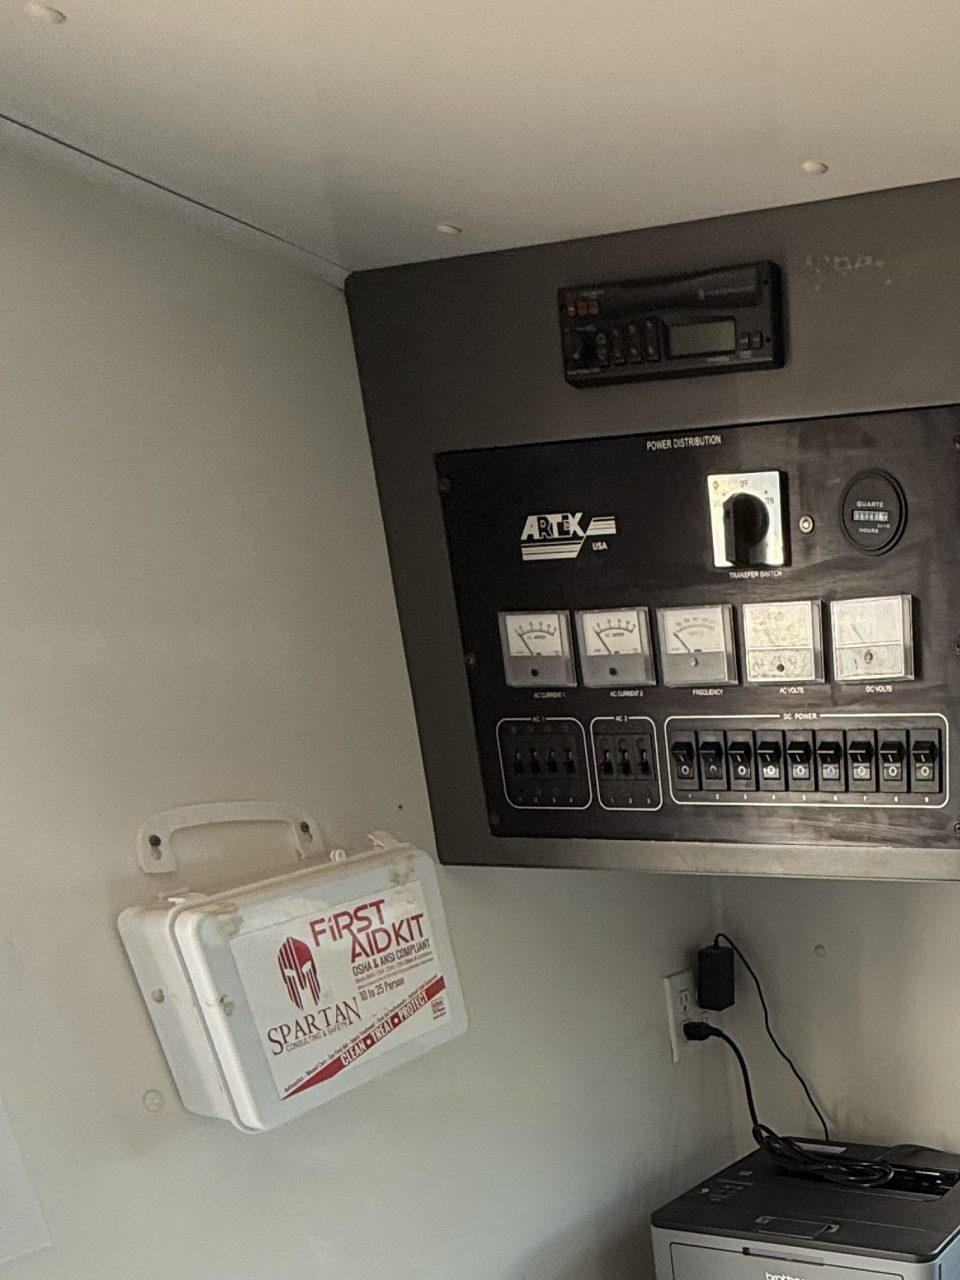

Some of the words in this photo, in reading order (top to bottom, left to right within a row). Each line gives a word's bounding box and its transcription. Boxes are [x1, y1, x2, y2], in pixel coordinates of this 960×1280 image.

[646, 439, 672, 450] POWER
[673, 435, 721, 448] DISTRIBUTION
[520, 512, 584, 540] ARTEX
[592, 542, 608, 550] USA
[729, 571, 759, 579] TRANSFER
[760, 570, 782, 578] SWITCH
[875, 685, 893, 693] VOLTS
[351, 925, 392, 963] AID
[392, 913, 424, 946] KIT
[352, 962, 373, 977] OSHA
[374, 959, 380, 969] &
[380, 954, 396, 966] ANSI
[396, 938, 431, 960] COMPLIANT
[359, 990, 368, 1001] 10
[368, 988, 376, 998] to
[376, 985, 385, 995] 25
[385, 978, 405, 992] Person
[267, 996, 362, 1056] SPARTAN
[286, 1031, 322, 1052] CONSULTING
[328, 1022, 347, 1035] SAFETY
[340, 1039, 367, 1065] CLEAN
[371, 1019, 394, 1042] TREAT
[399, 991, 430, 1022] PROTECT
